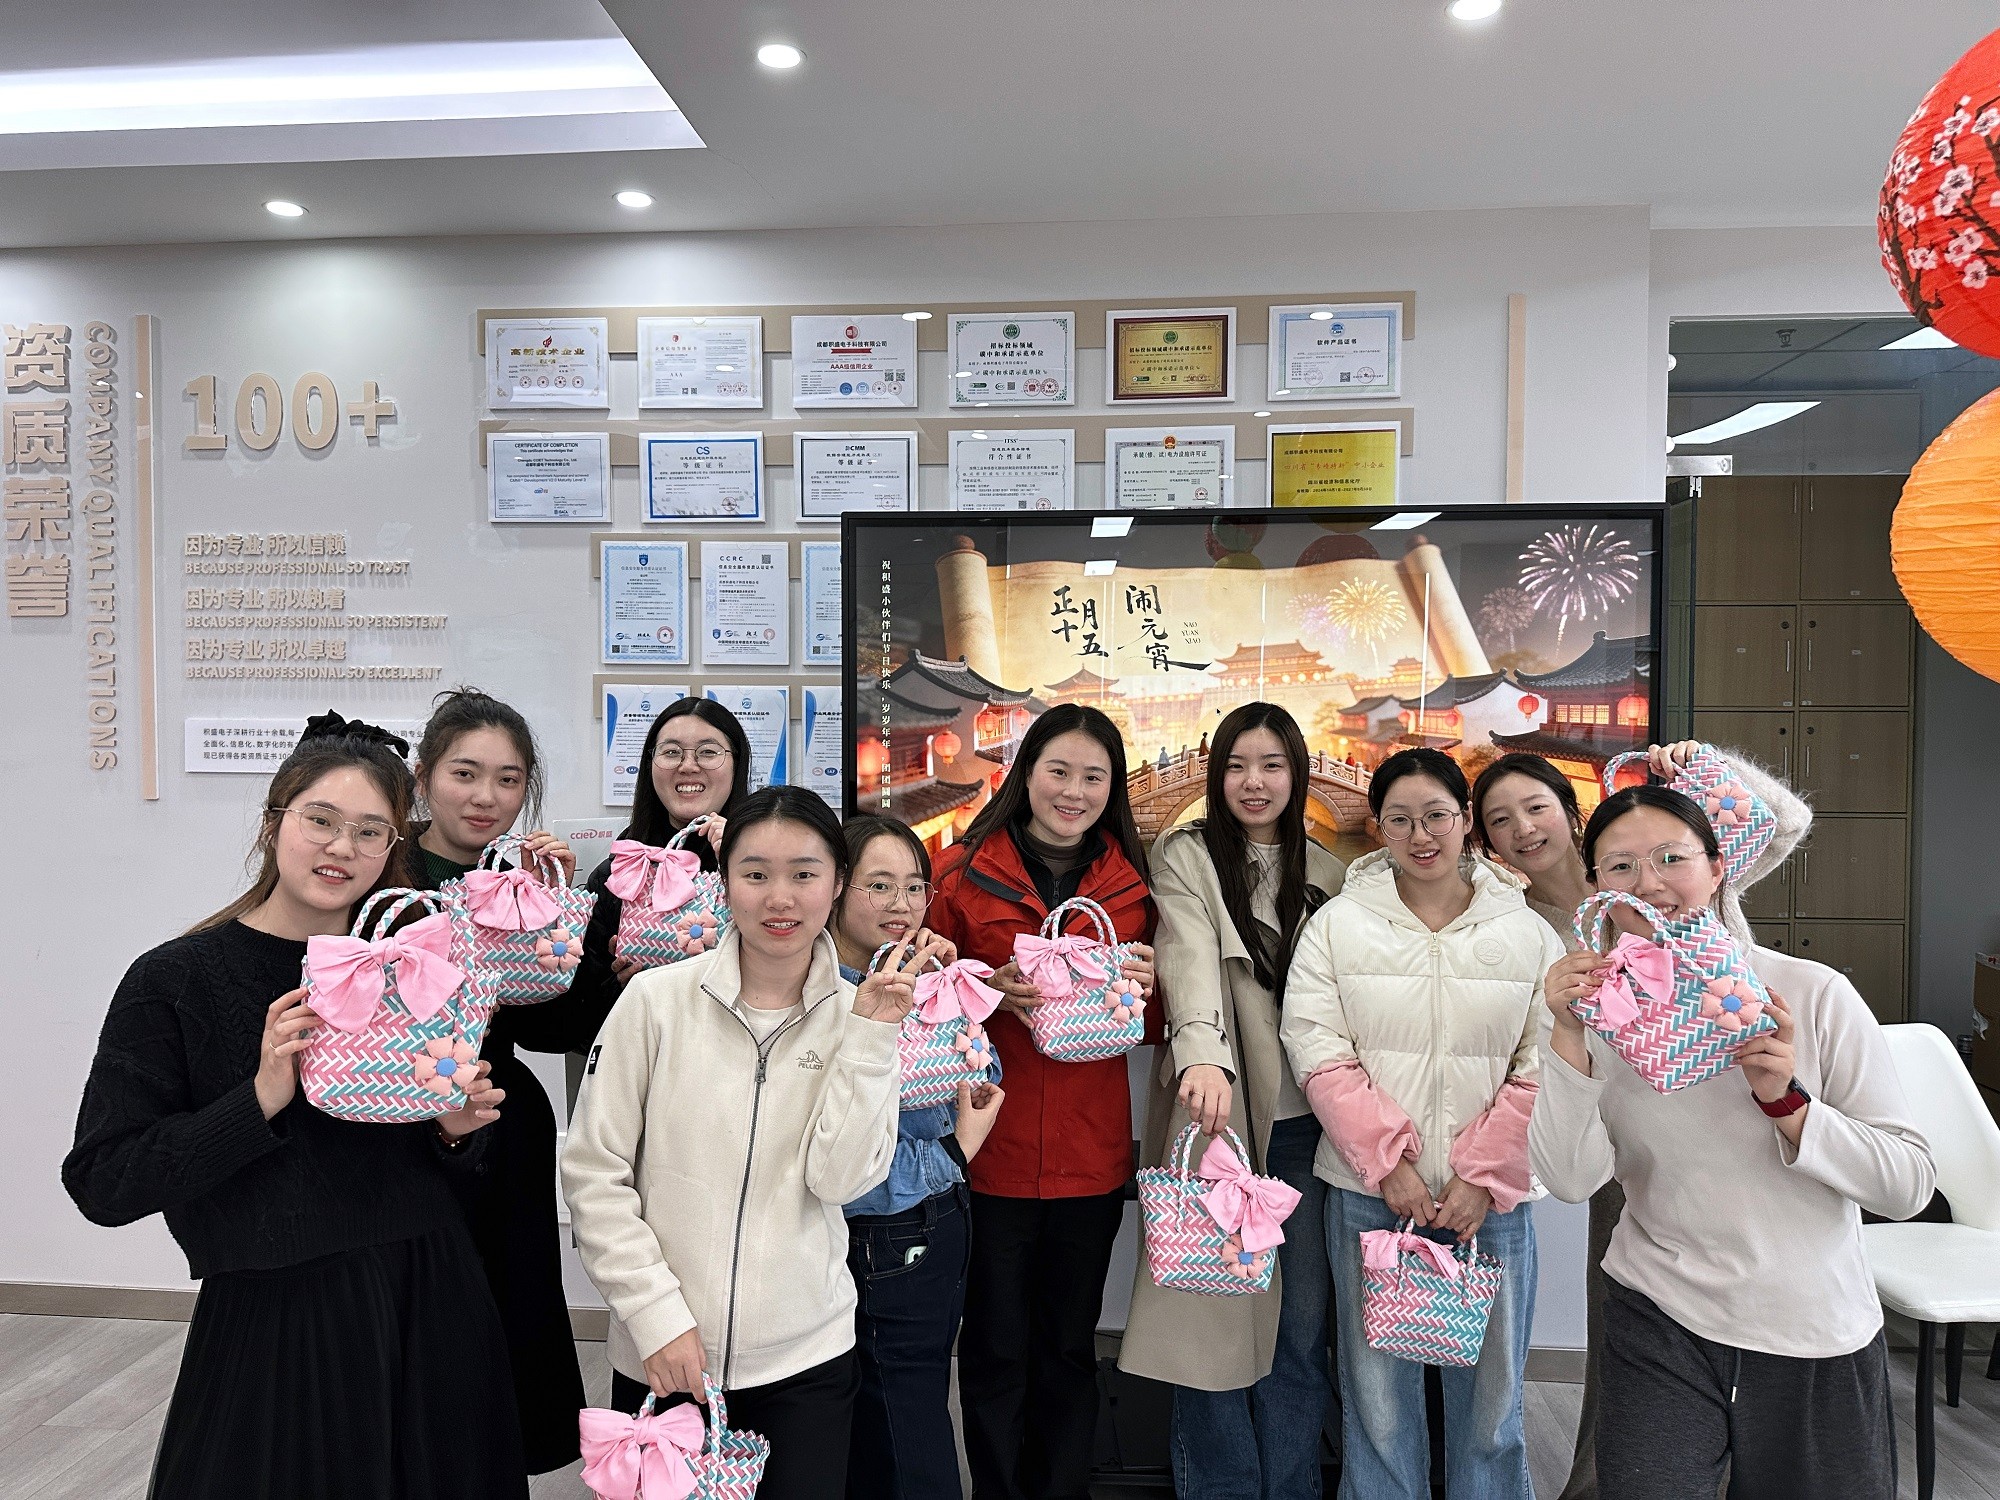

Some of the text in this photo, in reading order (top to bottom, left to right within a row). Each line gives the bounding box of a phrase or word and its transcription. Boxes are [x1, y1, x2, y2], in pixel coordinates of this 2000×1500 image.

[185, 372, 395, 451] 100+
[696, 446, 710, 455] CS
[4, 322, 70, 617] 资质荣誉
[80, 320, 118, 770] COMPANY QUALIFICATIONS
[185, 533, 347, 556] 因为专业 所以信赖
[185, 561, 410, 574] BECAUSE PROFESSIONAL SO TRUST
[186, 588, 346, 610] 因为专业 所以执着
[185, 615, 448, 628] BECAUSE PROFESSIONAL SO PERSISTENT
[186, 640, 346, 660] 因为专业 所以卓越
[186, 666, 442, 680] BECAUSE PROFESSIONAL SO EXCELLENT
[203, 740, 298, 748] 全面化、信息化、数字化的有
